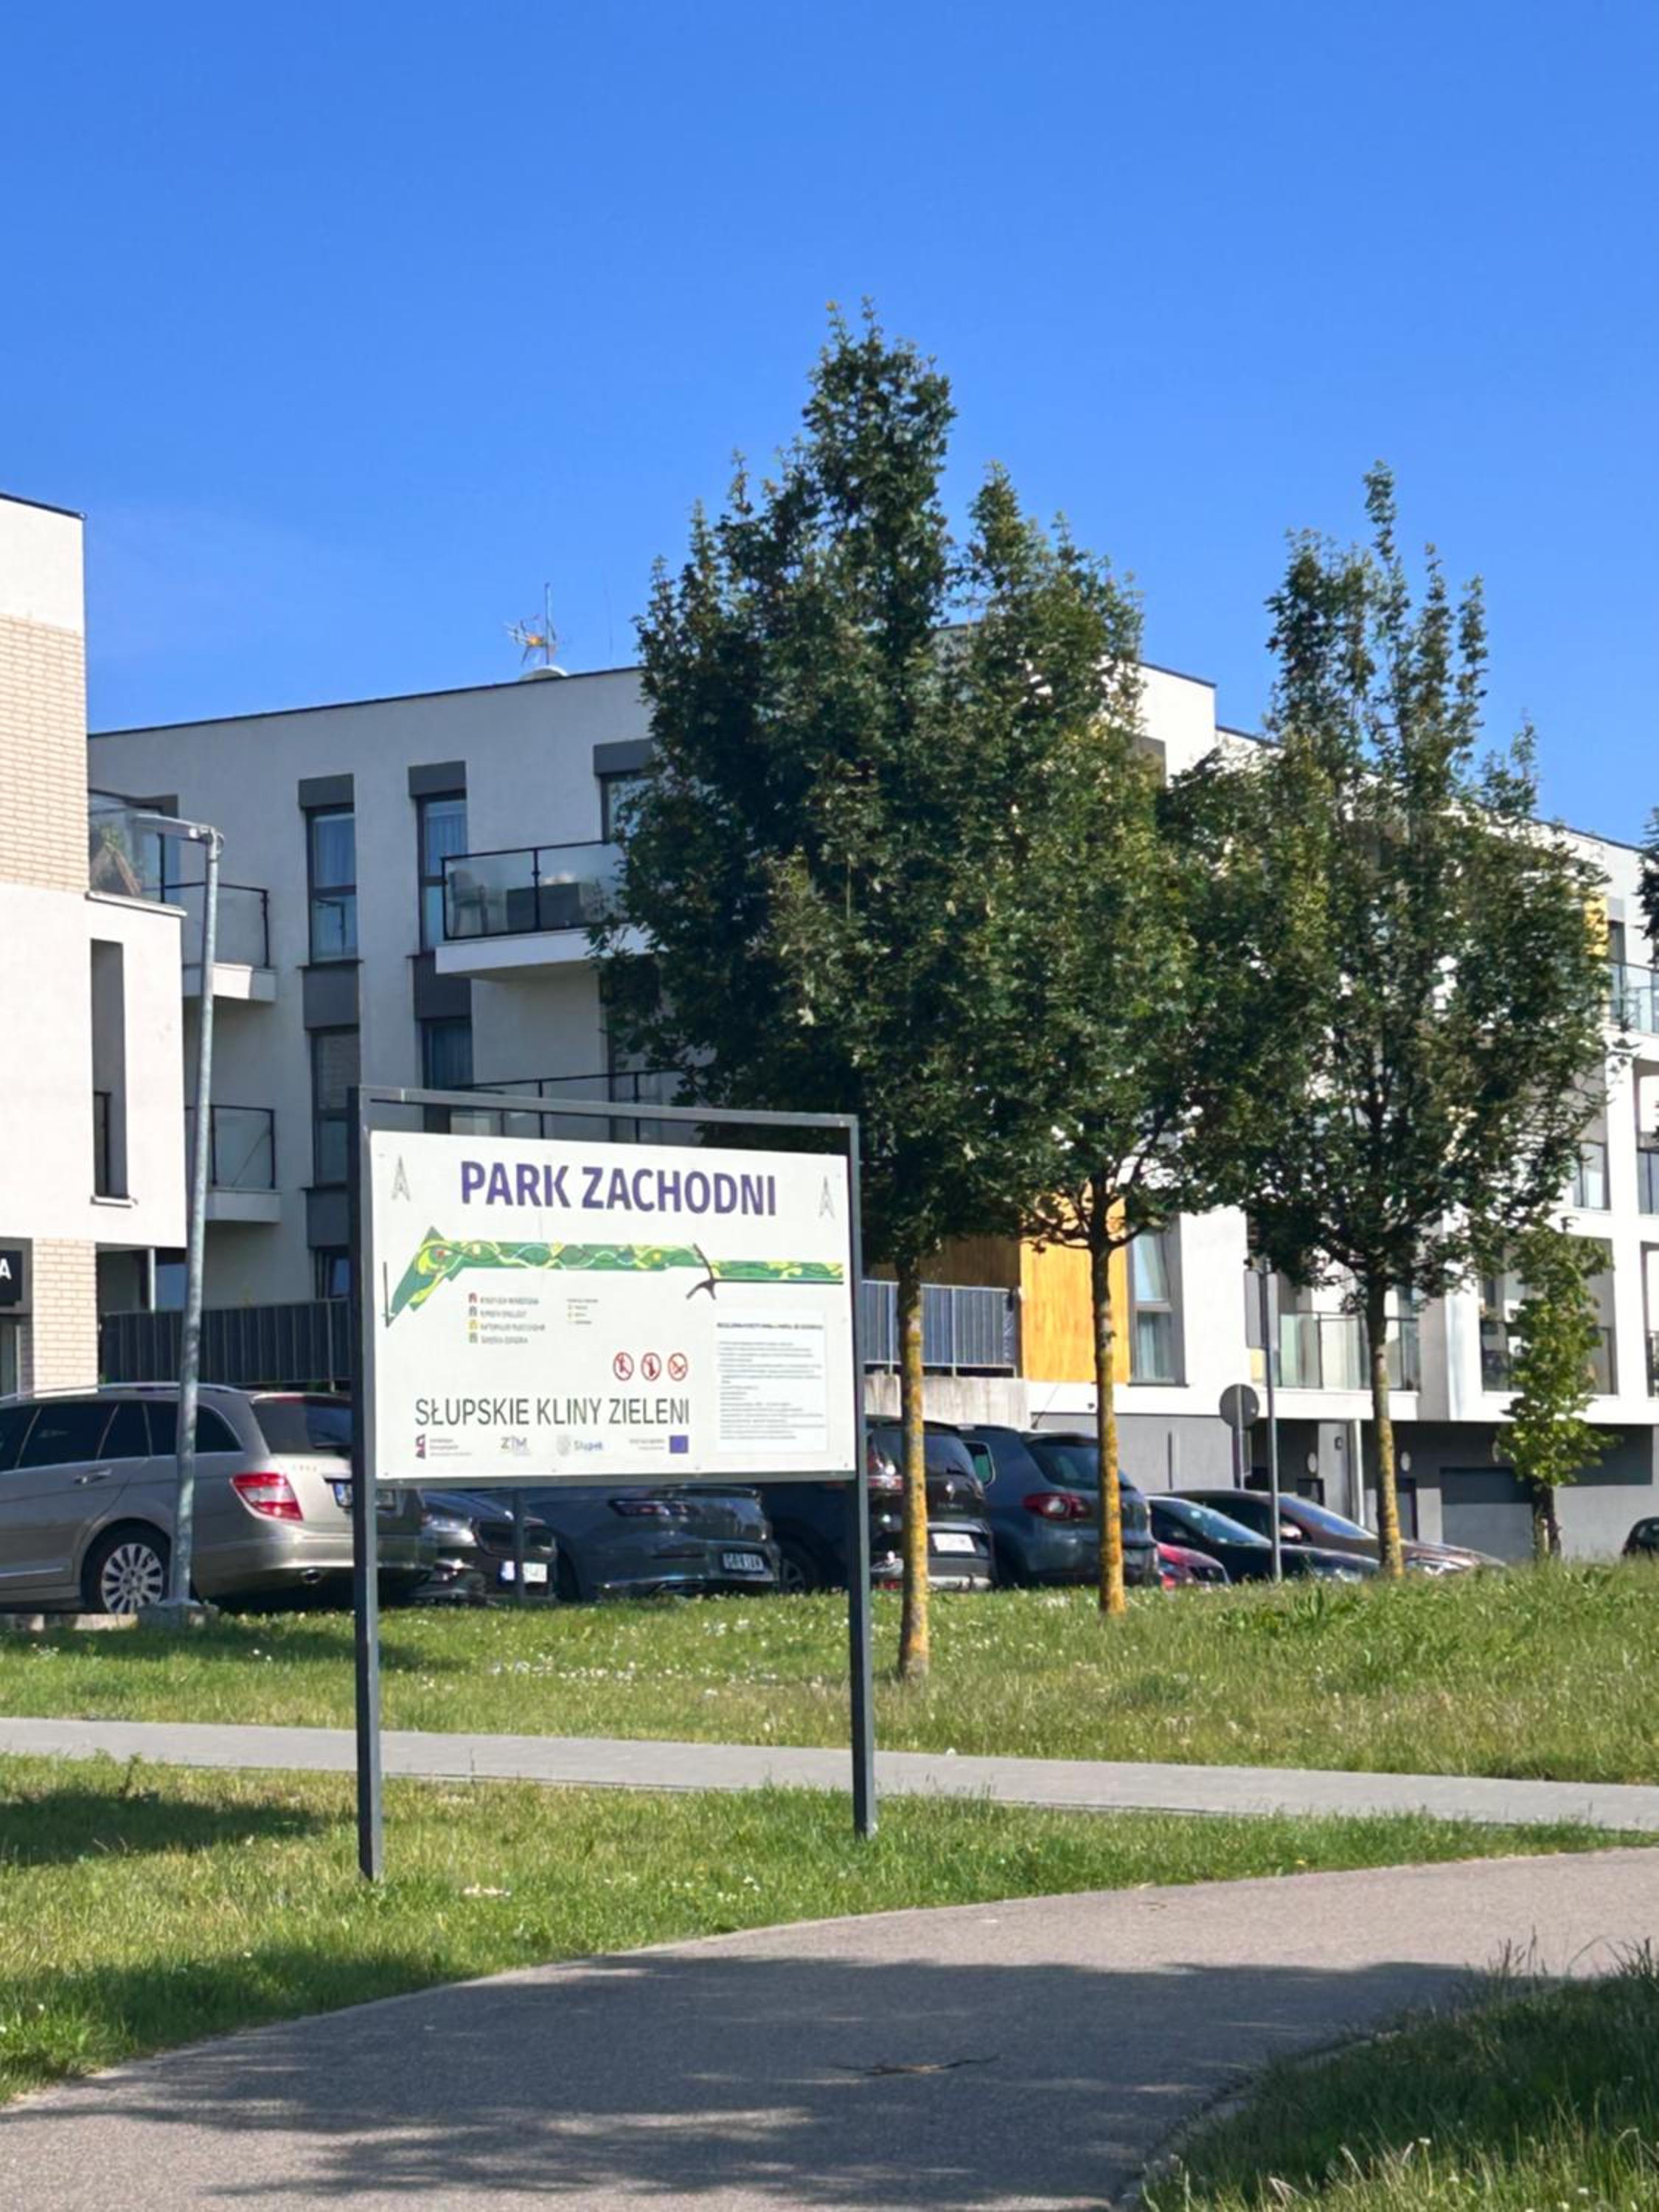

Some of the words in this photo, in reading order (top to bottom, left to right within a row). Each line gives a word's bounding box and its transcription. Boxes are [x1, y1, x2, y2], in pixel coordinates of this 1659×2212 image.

[461, 1161, 571, 1208] PARK
[581, 1166, 776, 1216] ZACHODNI
[414, 1398, 530, 1425] SŁUPSKIE
[537, 1398, 602, 1425] KLINY
[608, 1398, 690, 1425] ZIELENI
